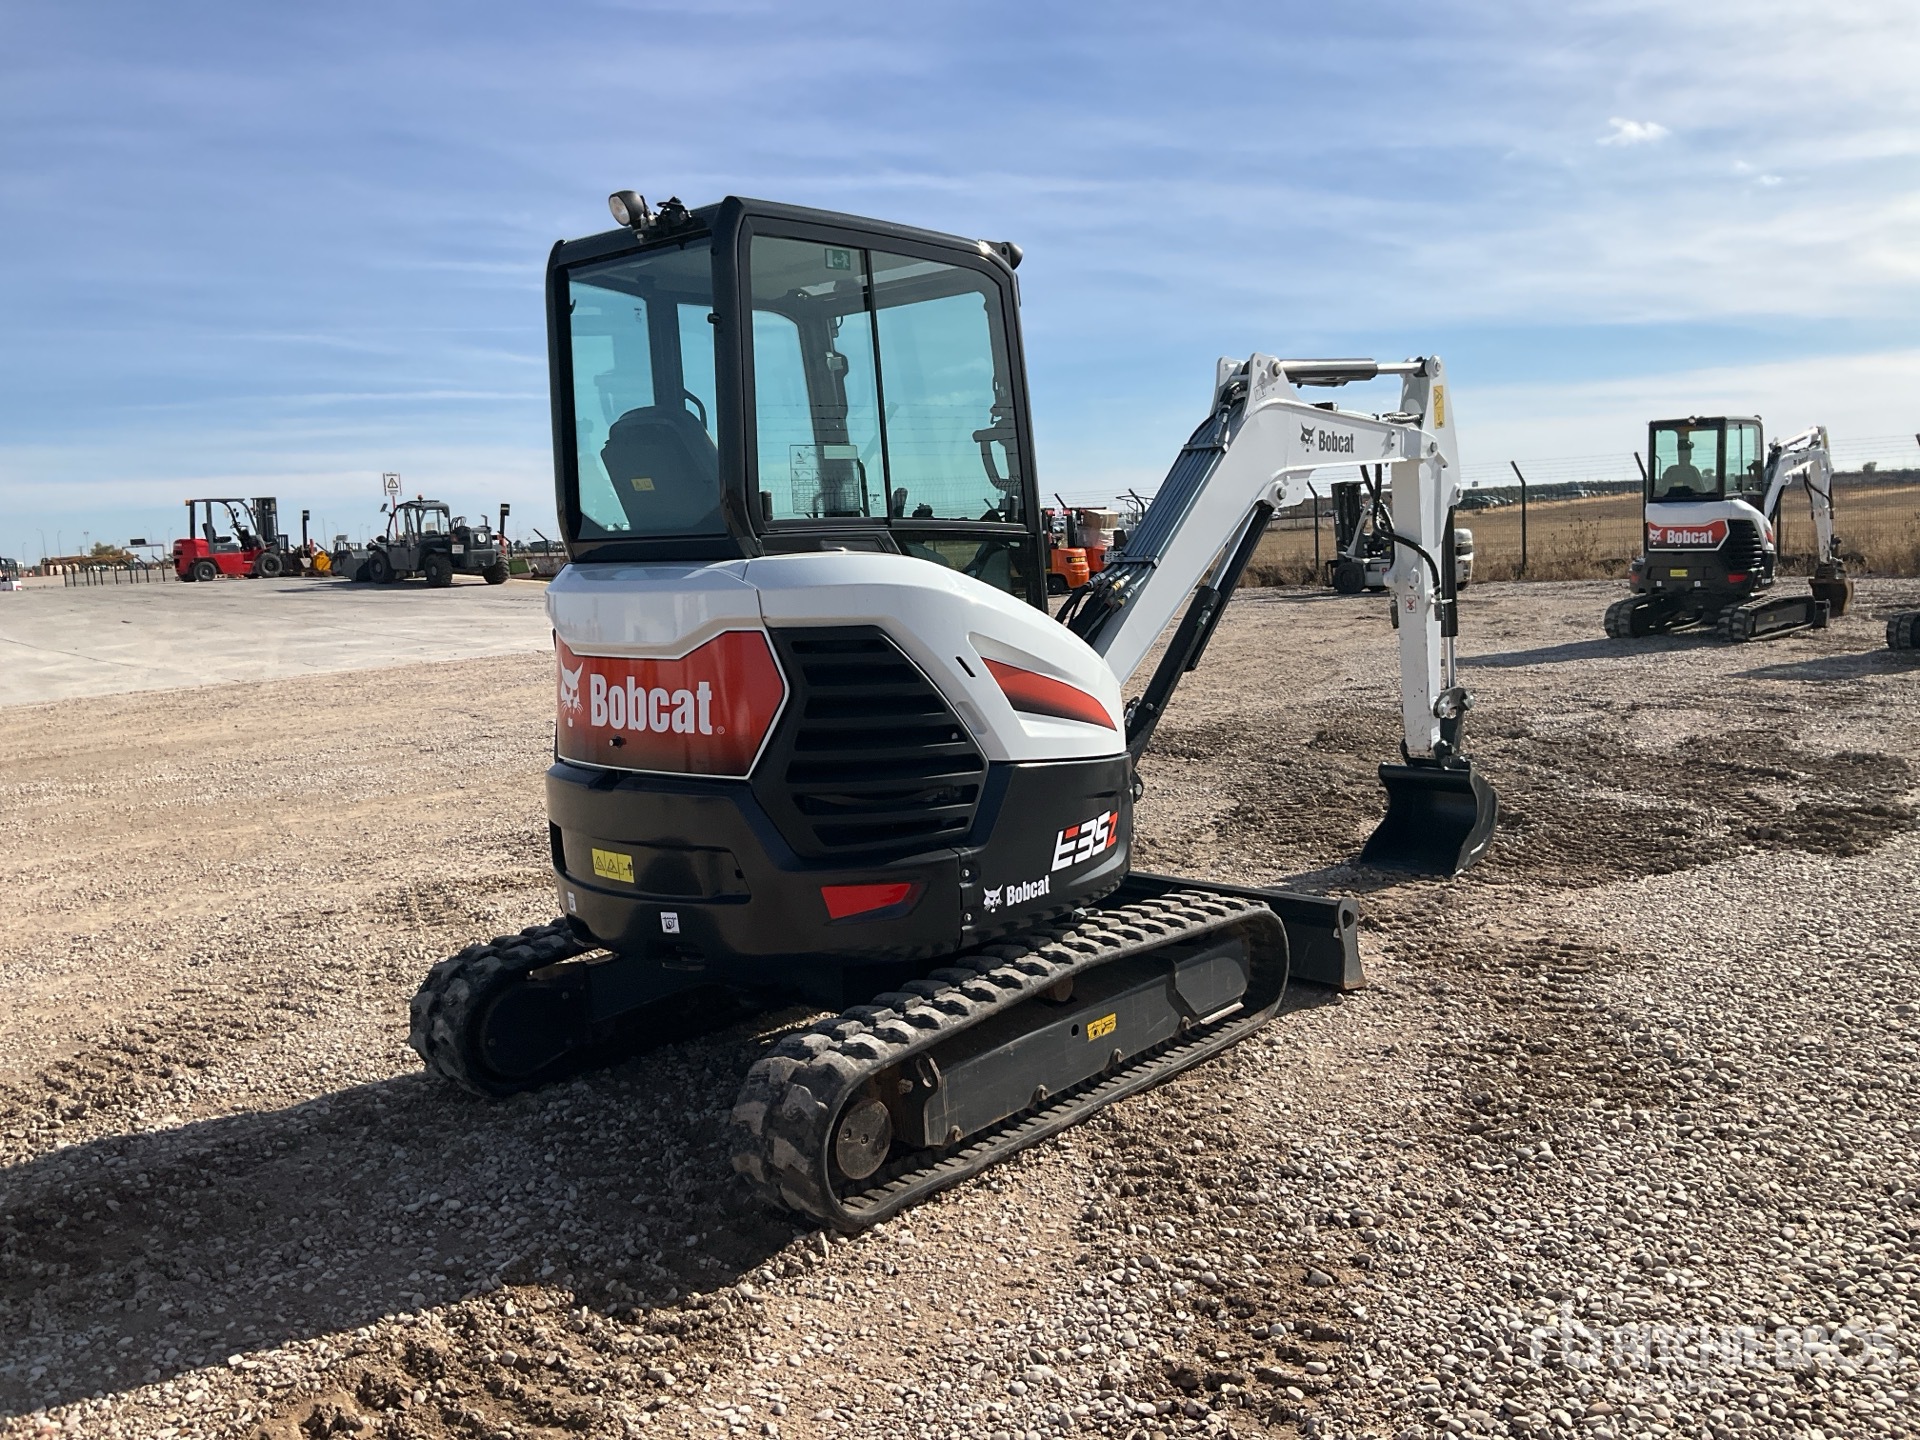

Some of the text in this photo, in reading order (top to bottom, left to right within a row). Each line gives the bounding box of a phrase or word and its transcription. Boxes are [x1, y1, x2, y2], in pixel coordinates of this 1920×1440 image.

[1318, 430, 1355, 454] Bobcat
[1667, 530, 1713, 544] Bobcat
[590, 673, 713, 735] Bobcat
[1006, 874, 1051, 907] Bobcat
